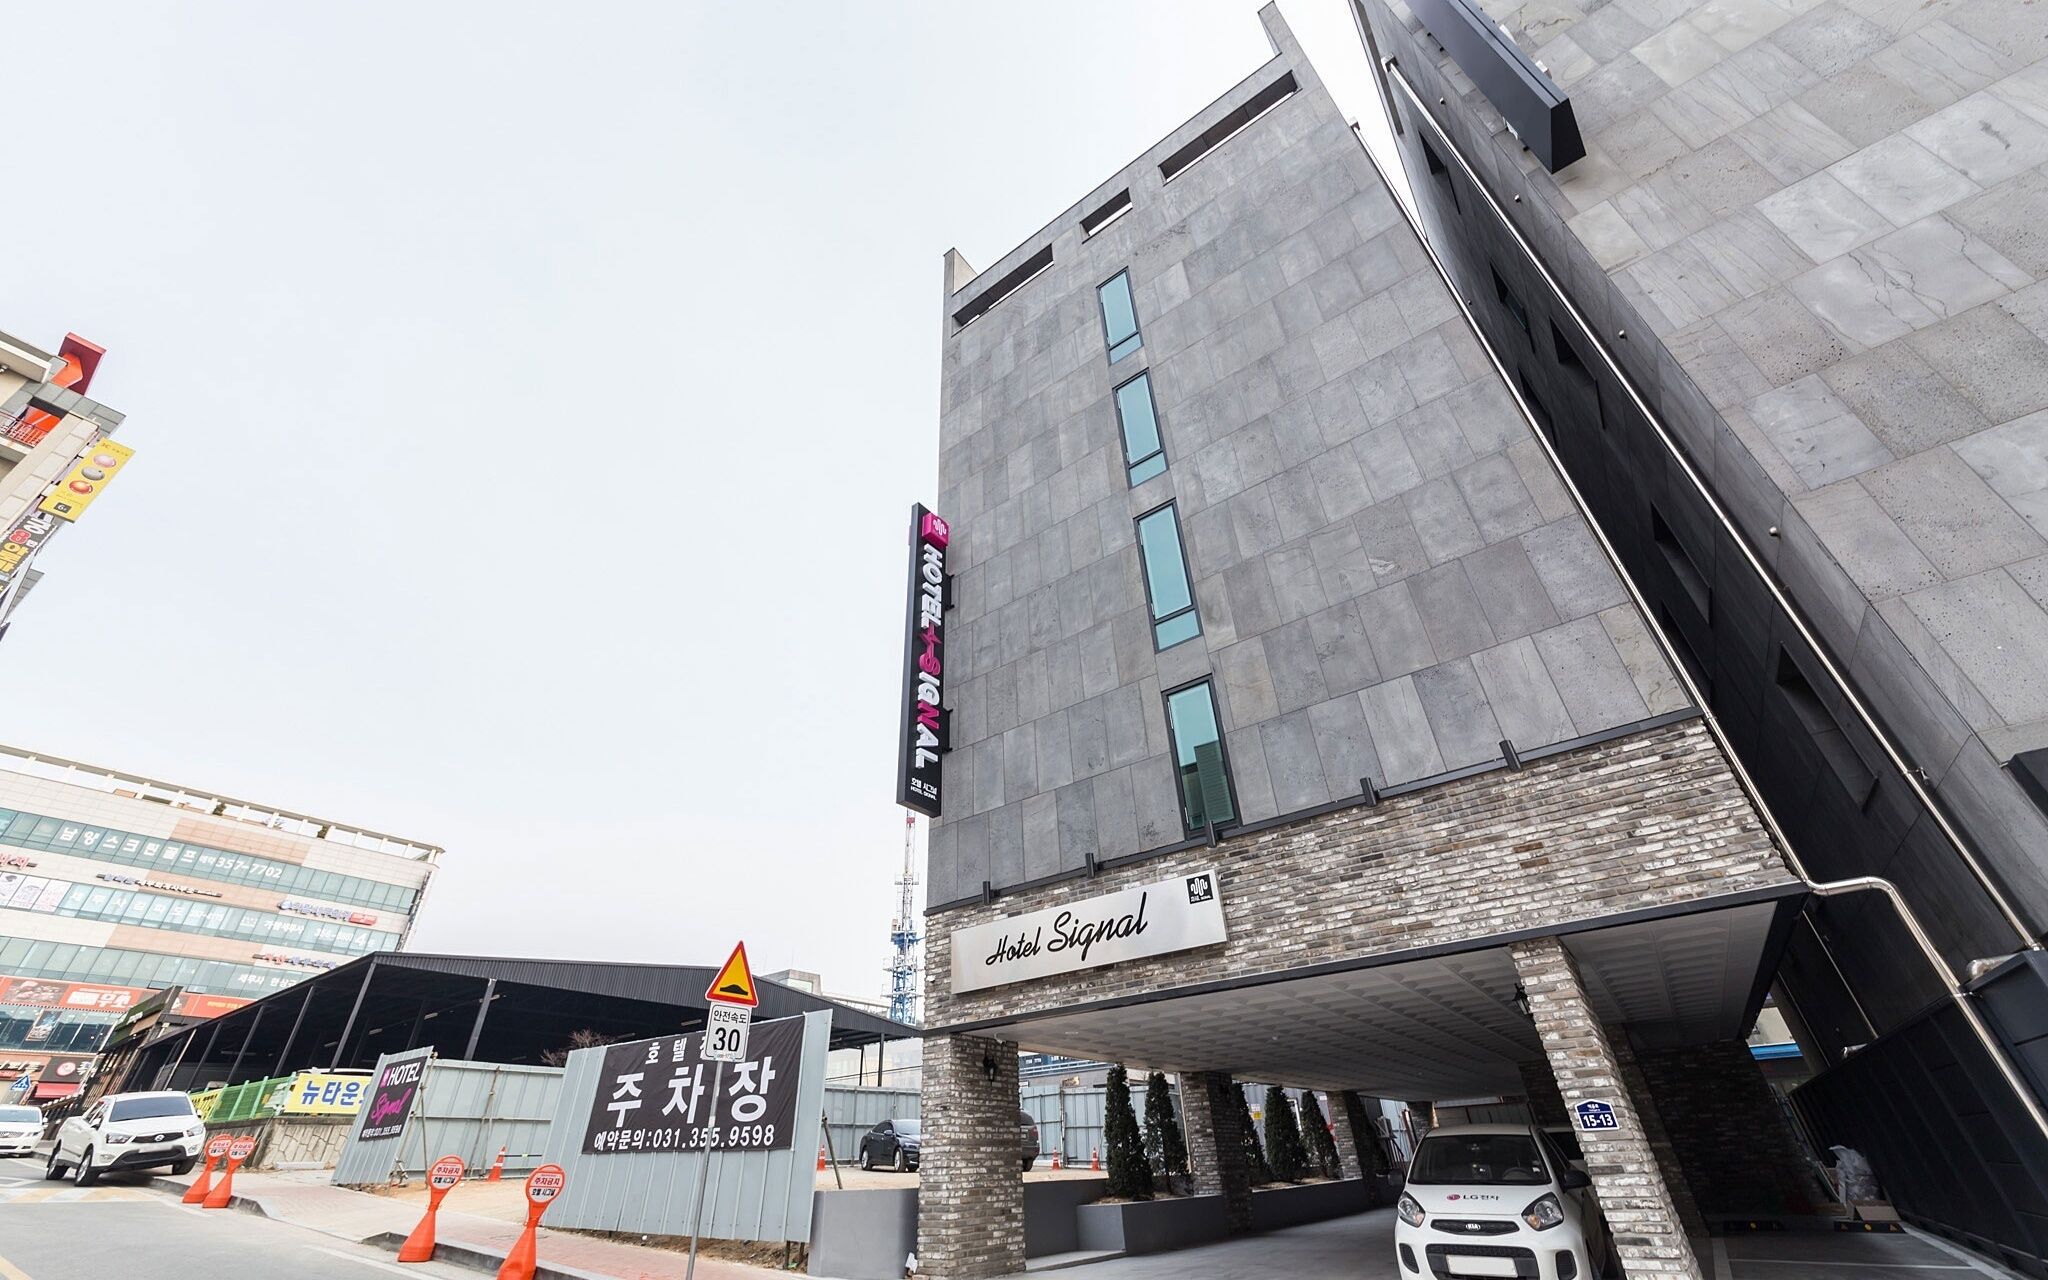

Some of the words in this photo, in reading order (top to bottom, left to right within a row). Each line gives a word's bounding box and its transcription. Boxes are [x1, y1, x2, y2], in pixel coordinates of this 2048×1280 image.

[920, 543, 943, 629] HOTEL
[915, 653, 941, 769] SIGNAL
[215, 856, 283, 879] 357-7702
[985, 926, 1041, 966] Hotel
[1047, 891, 1148, 962] Signal
[713, 1010, 747, 1024] 안전속도
[713, 1027, 741, 1052] 30
[387, 1062, 421, 1087] HOTEL
[301, 1080, 371, 1107] 뉴타운
[606, 1056, 777, 1128] 주차장
[1583, 1114, 1614, 1127] 15-13
